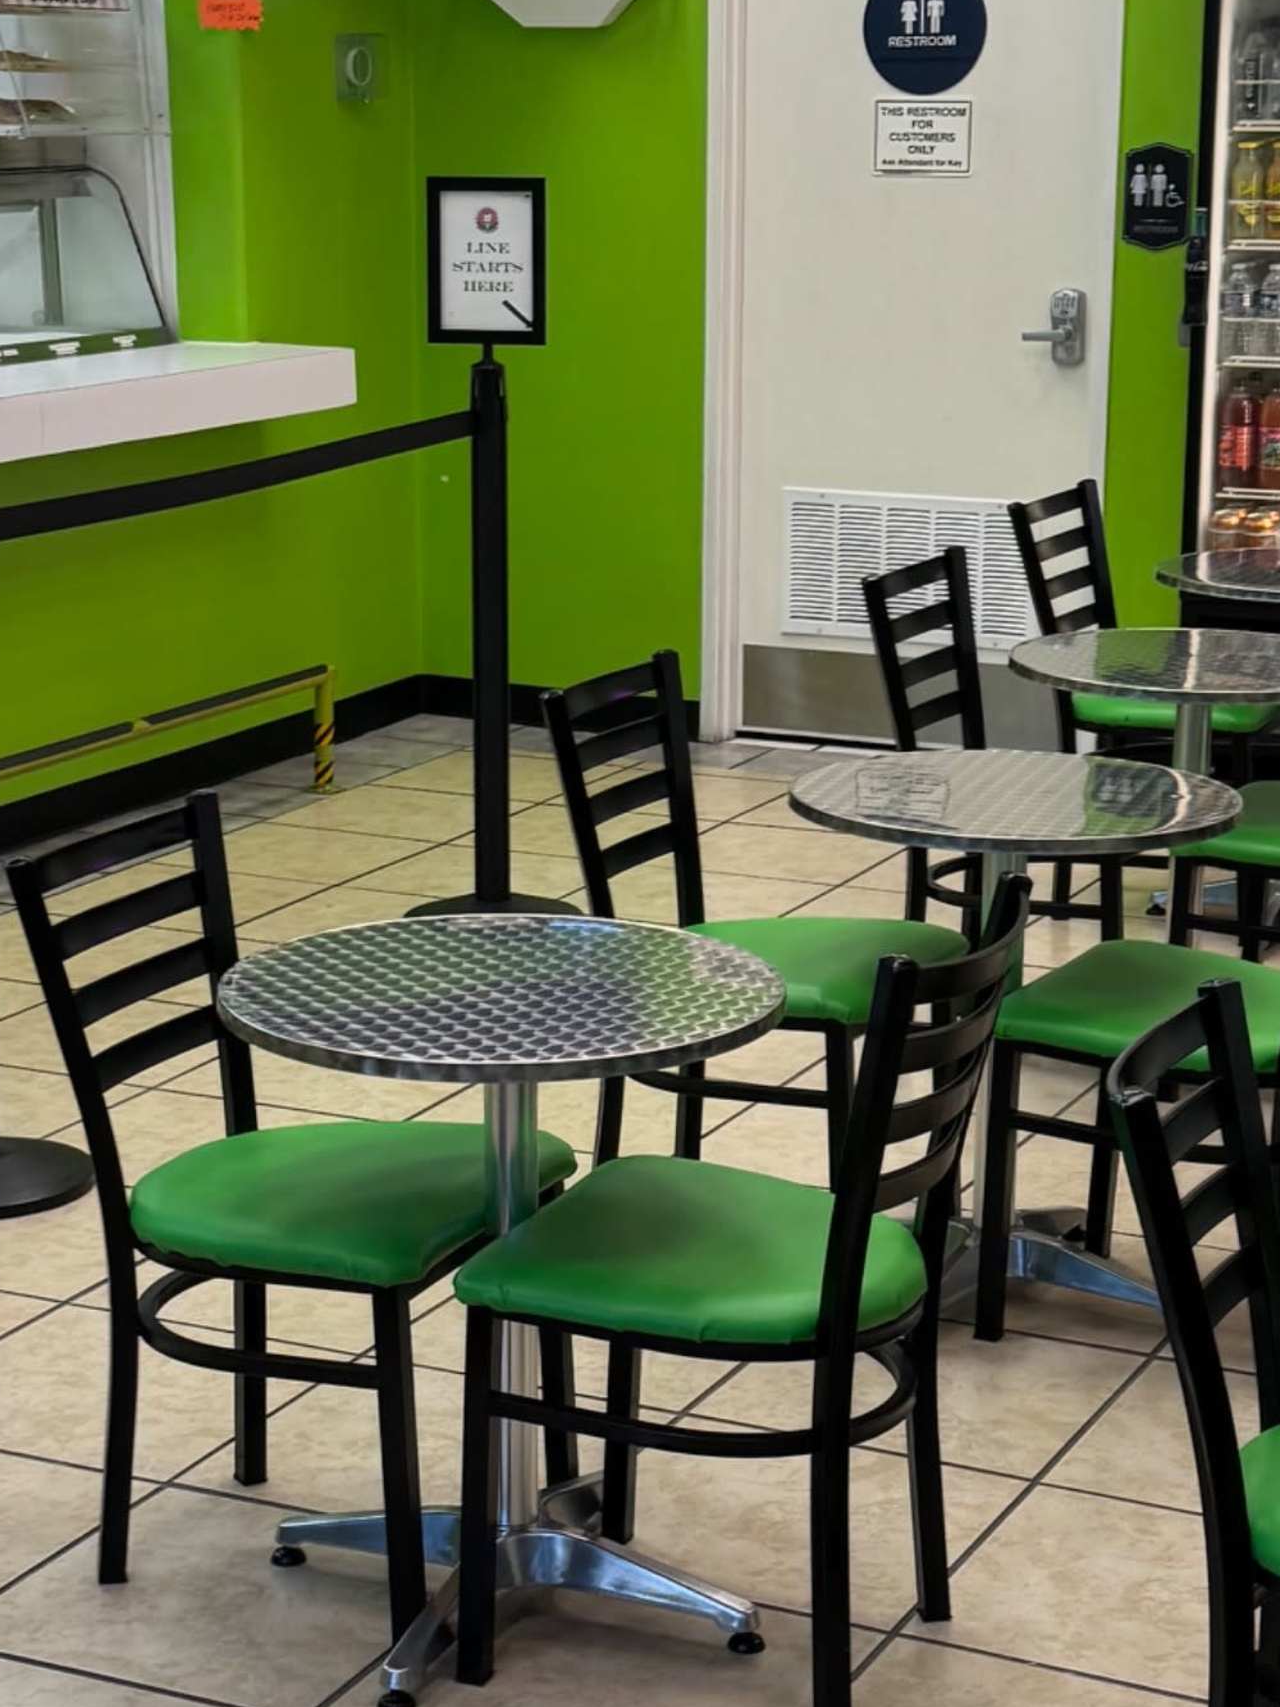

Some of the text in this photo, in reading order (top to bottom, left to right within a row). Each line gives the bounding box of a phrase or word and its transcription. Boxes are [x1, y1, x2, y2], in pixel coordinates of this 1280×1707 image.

[887, 35, 957, 48] RESTROOM
[880, 106, 967, 118] THIS RESTROOM
[911, 119, 934, 130] FOR
[888, 132, 956, 143] CUSTOMERS
[907, 144, 936, 155] ONLY
[466, 241, 511, 255] LINE
[452, 260, 524, 273] STARTS
[463, 280, 515, 293] HERE
